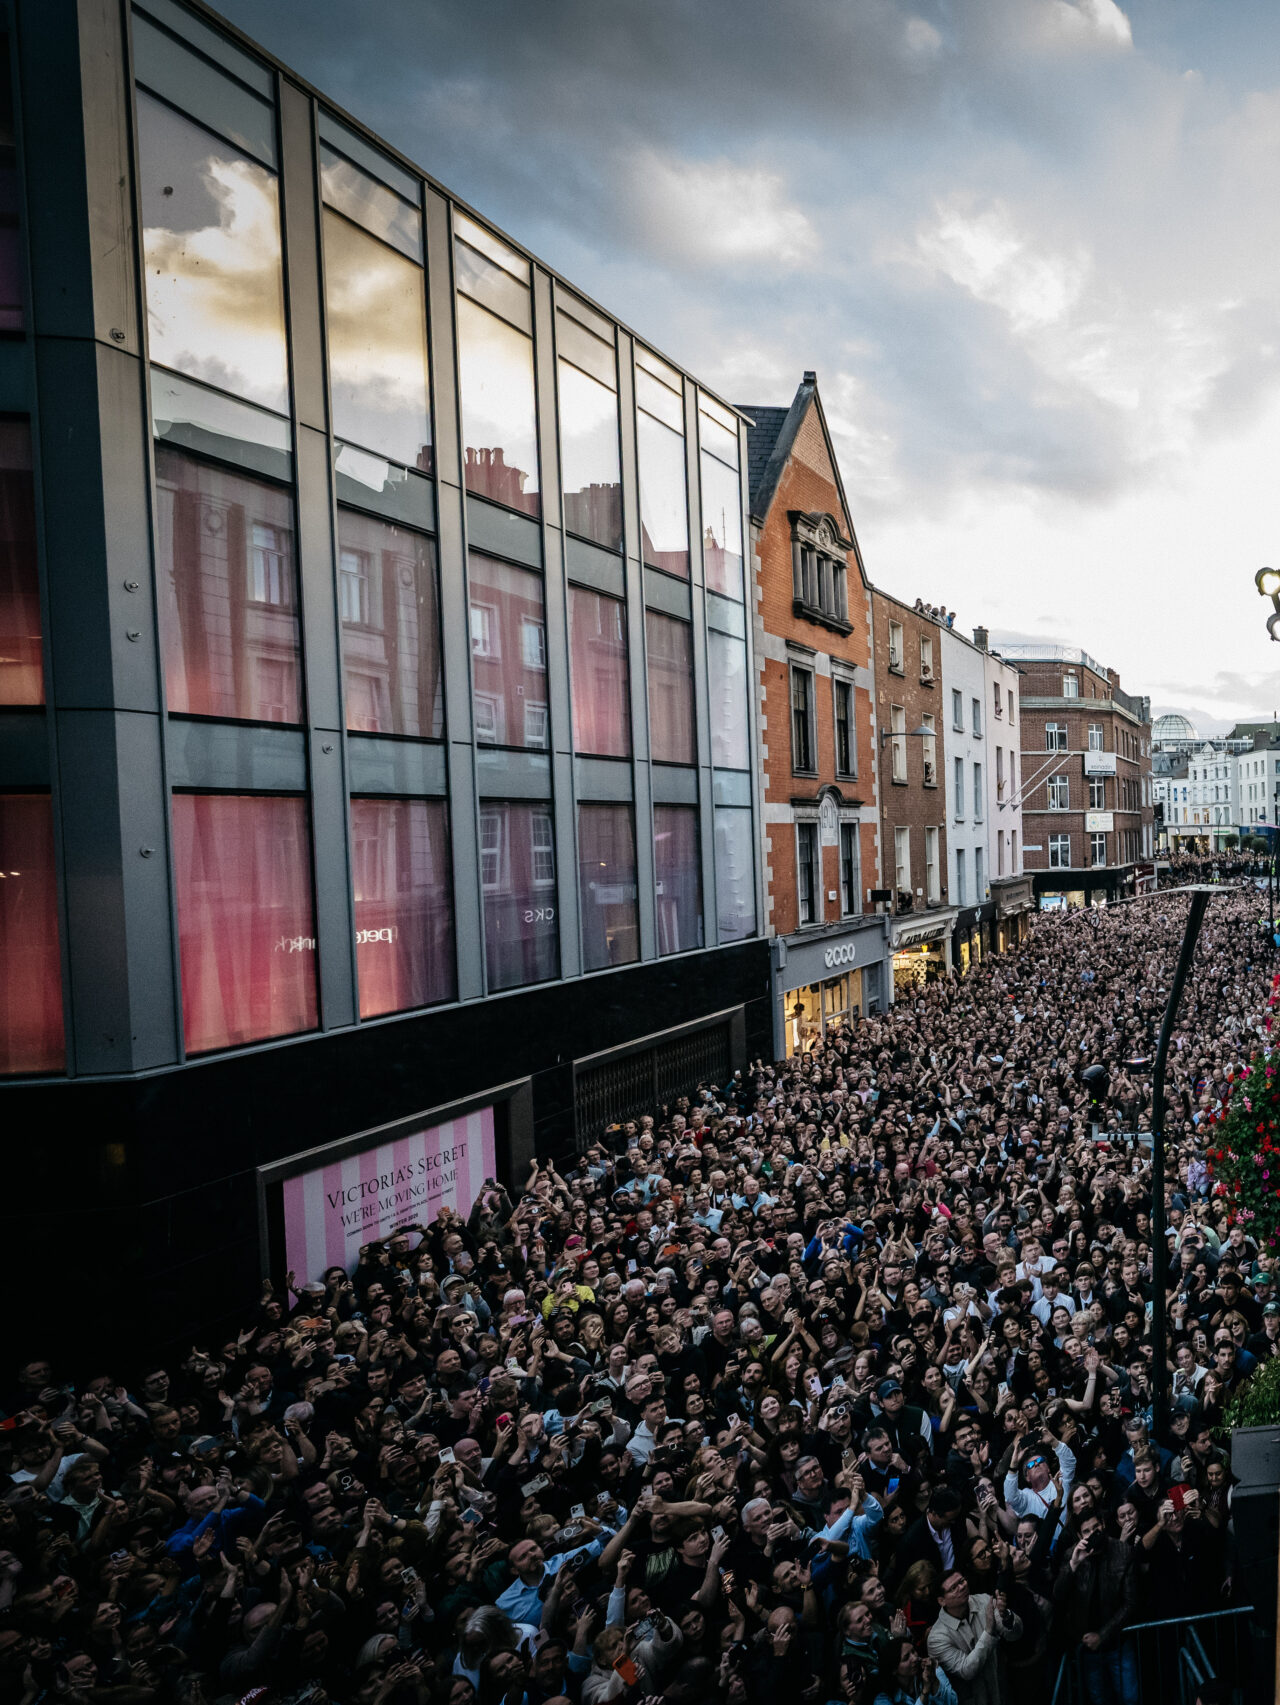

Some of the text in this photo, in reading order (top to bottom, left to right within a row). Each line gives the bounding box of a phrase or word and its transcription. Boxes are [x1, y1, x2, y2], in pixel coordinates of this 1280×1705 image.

[824, 943, 856, 968] ecco
[327, 1142, 468, 1210] VICTORIA'S SECRET
[340, 1202, 377, 1228] WE'RE
[378, 1182, 426, 1214] MOVING
[426, 1168, 460, 1195] HOME
